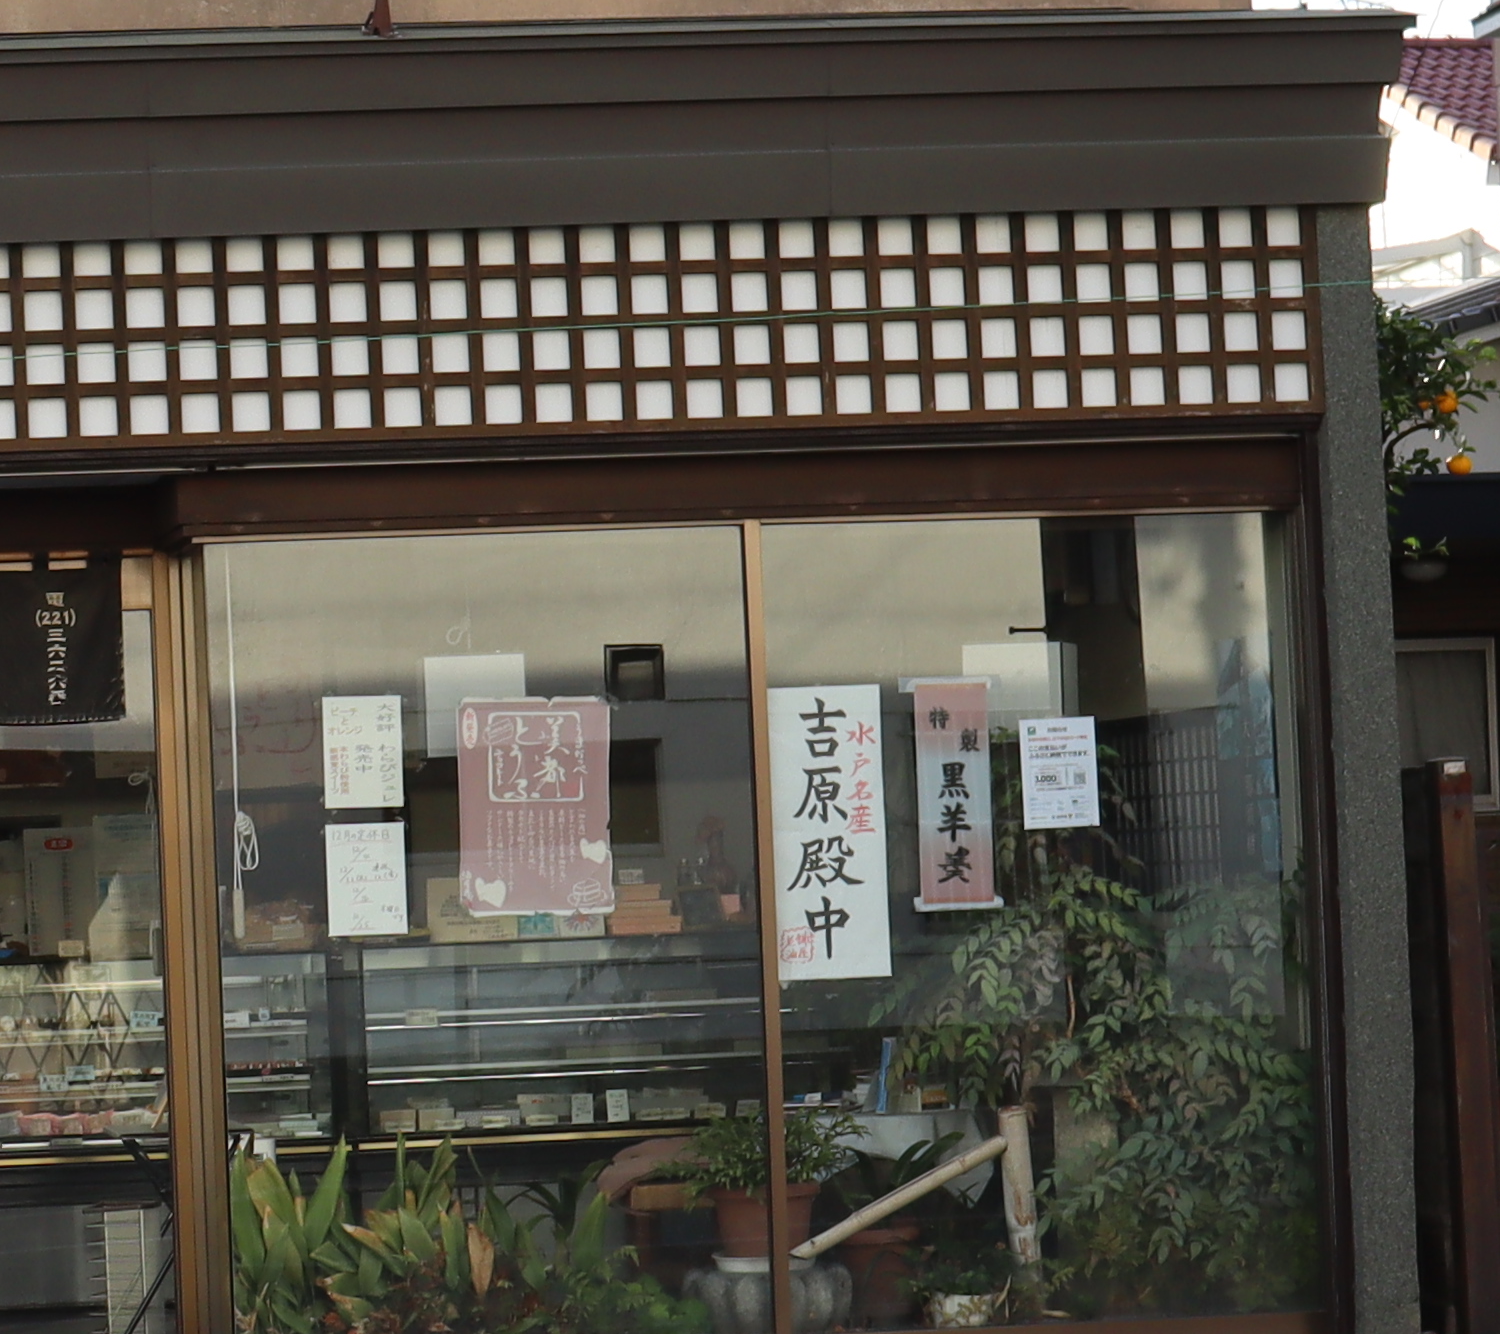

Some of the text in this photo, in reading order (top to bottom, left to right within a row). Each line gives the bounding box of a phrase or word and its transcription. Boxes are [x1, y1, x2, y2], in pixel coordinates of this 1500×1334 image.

[327, 726, 363, 736] オレンジ
[376, 703, 397, 733] 大好評
[929, 707, 980, 753] 特製
[354, 744, 374, 773] 発売中
[845, 721, 876, 834] 水戸名産
[787, 697, 865, 959] 吉原殿中
